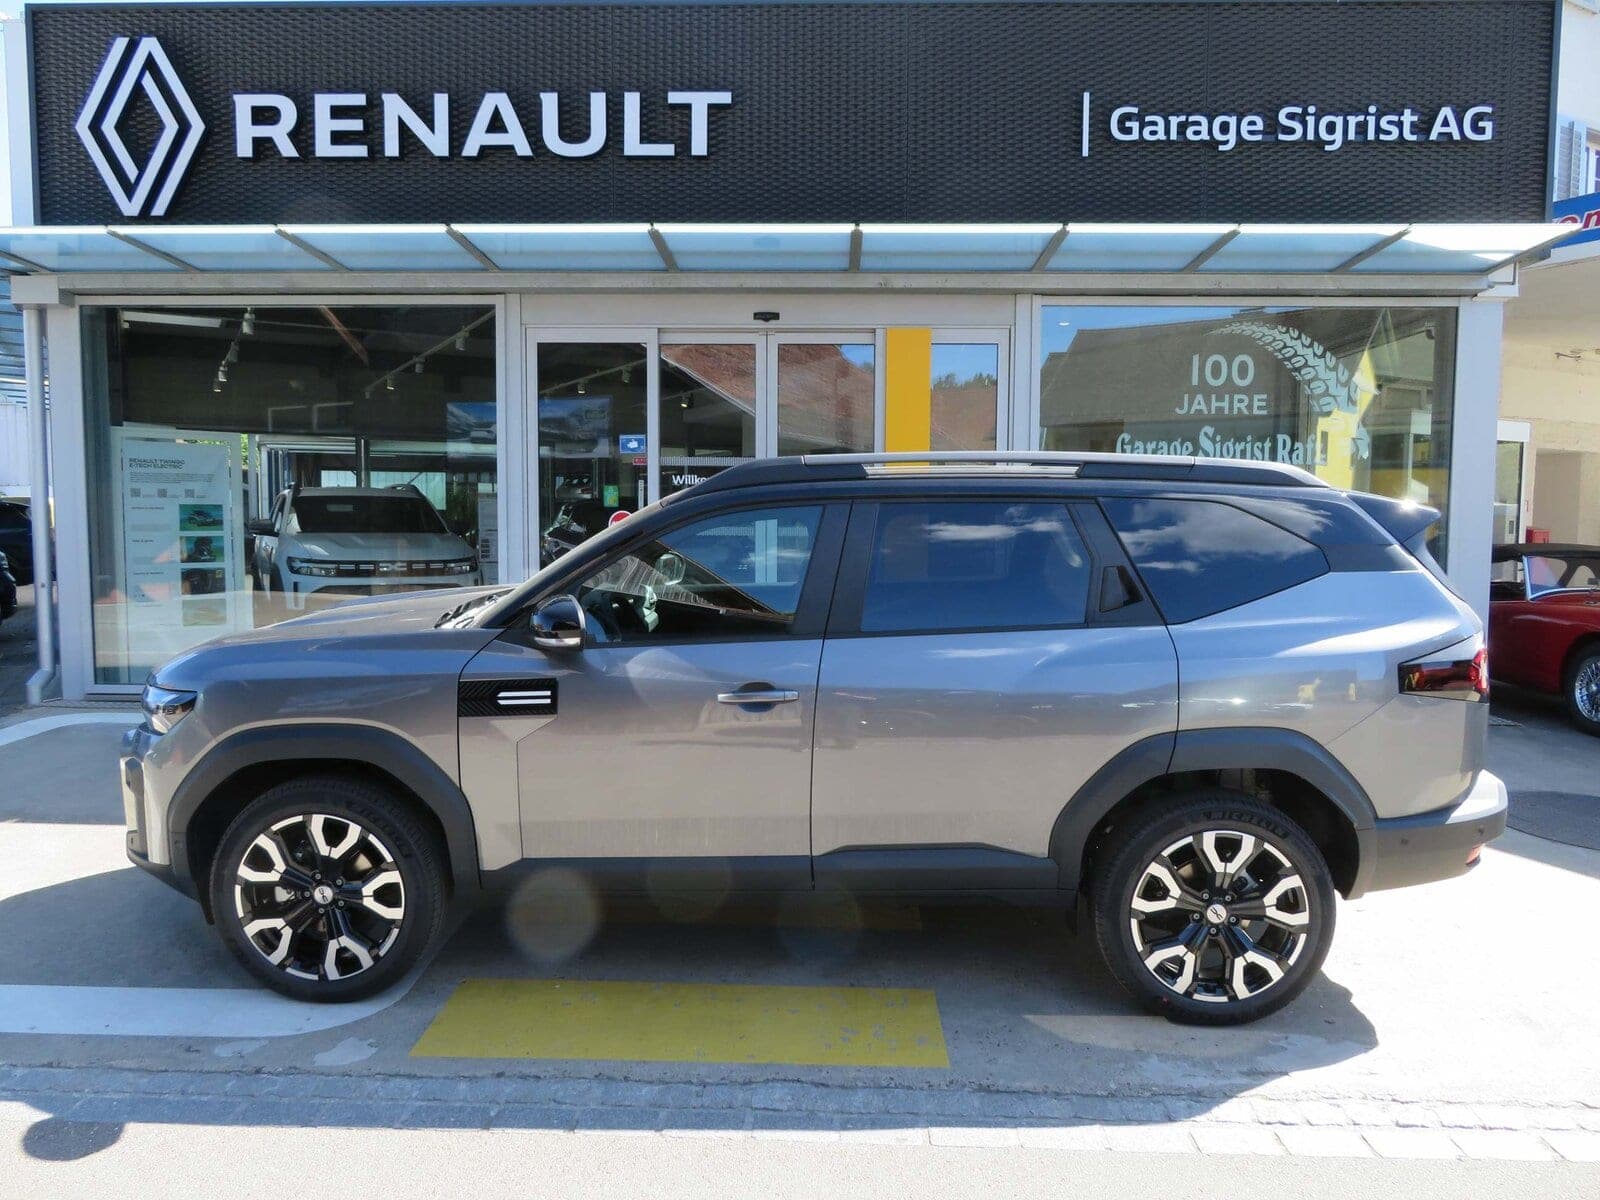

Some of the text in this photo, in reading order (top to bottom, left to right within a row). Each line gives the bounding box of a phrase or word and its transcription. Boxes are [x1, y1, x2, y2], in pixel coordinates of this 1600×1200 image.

[233, 91, 732, 158] RENAULT
[1110, 105, 1493, 151] Garage Sigrist AG
[1191, 353, 1255, 387] 100
[1174, 393, 1268, 415] JAHRE
[1116, 432, 1193, 456] Garage
[1198, 425, 1272, 461] Sigrist
[671, 474, 709, 486] Willko
